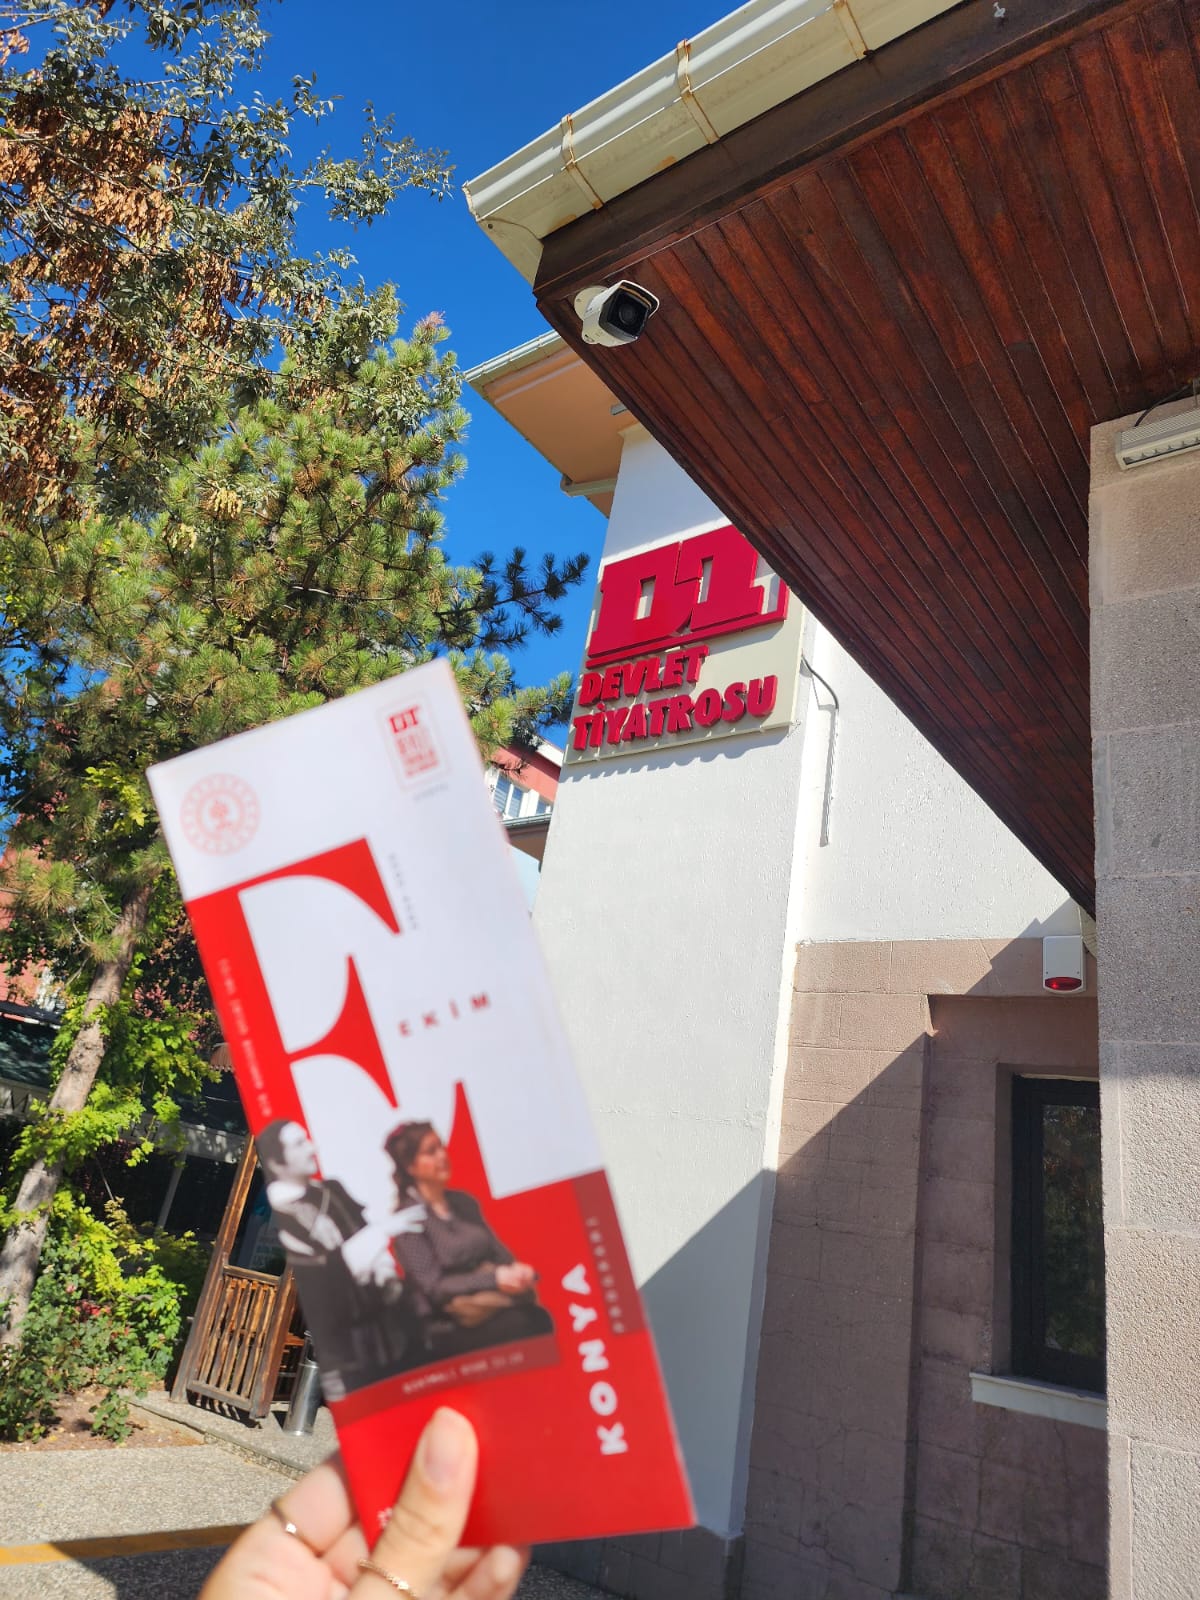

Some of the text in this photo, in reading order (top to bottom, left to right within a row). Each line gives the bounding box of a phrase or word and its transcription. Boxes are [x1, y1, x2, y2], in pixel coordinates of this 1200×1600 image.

[578, 644, 710, 706] DEVLET
[573, 674, 778, 751] TİYATROSU
[398, 992, 491, 1038] EKİM
[561, 1263, 629, 1456] KONYA
